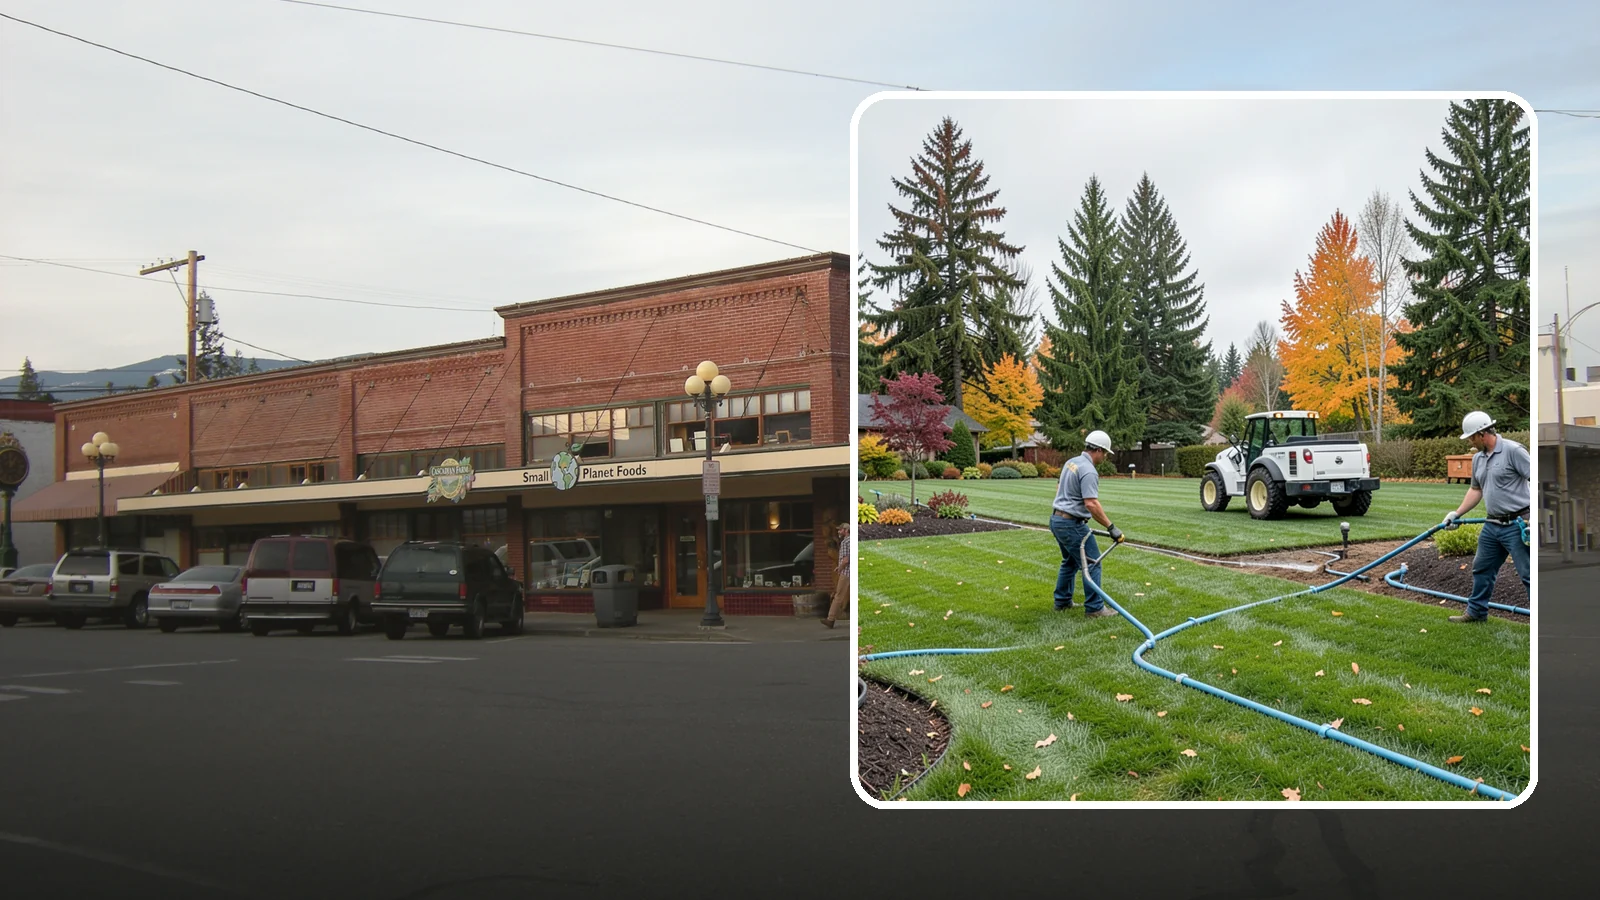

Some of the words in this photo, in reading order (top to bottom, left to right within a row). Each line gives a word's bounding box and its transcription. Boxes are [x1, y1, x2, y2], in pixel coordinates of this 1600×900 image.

[523, 471, 549, 483] Small
[583, 467, 614, 479] Planet
[617, 464, 647, 477] Foods
